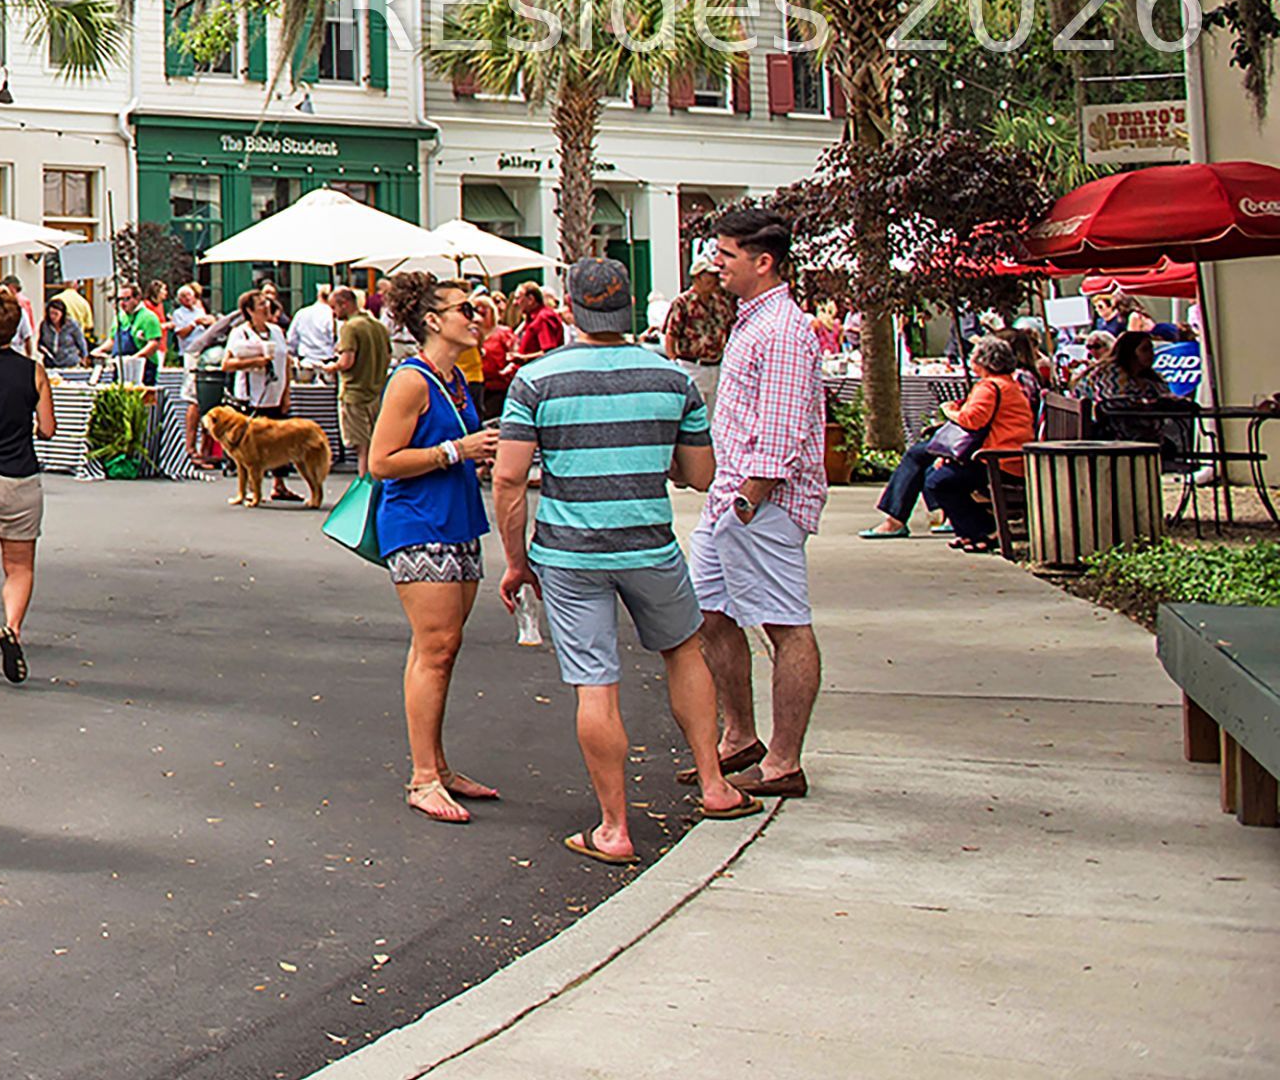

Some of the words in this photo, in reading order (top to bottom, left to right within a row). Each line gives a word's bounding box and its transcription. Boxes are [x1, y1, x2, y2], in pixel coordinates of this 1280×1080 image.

[1107, 106, 1186, 126] BERTO'S
[1118, 125, 1169, 140] GRILL
[220, 134, 243, 152] The
[244, 135, 280, 153] Bible
[282, 136, 338, 156] Student
[1151, 353, 1201, 370] BUD
[1161, 369, 1203, 383] GHT
